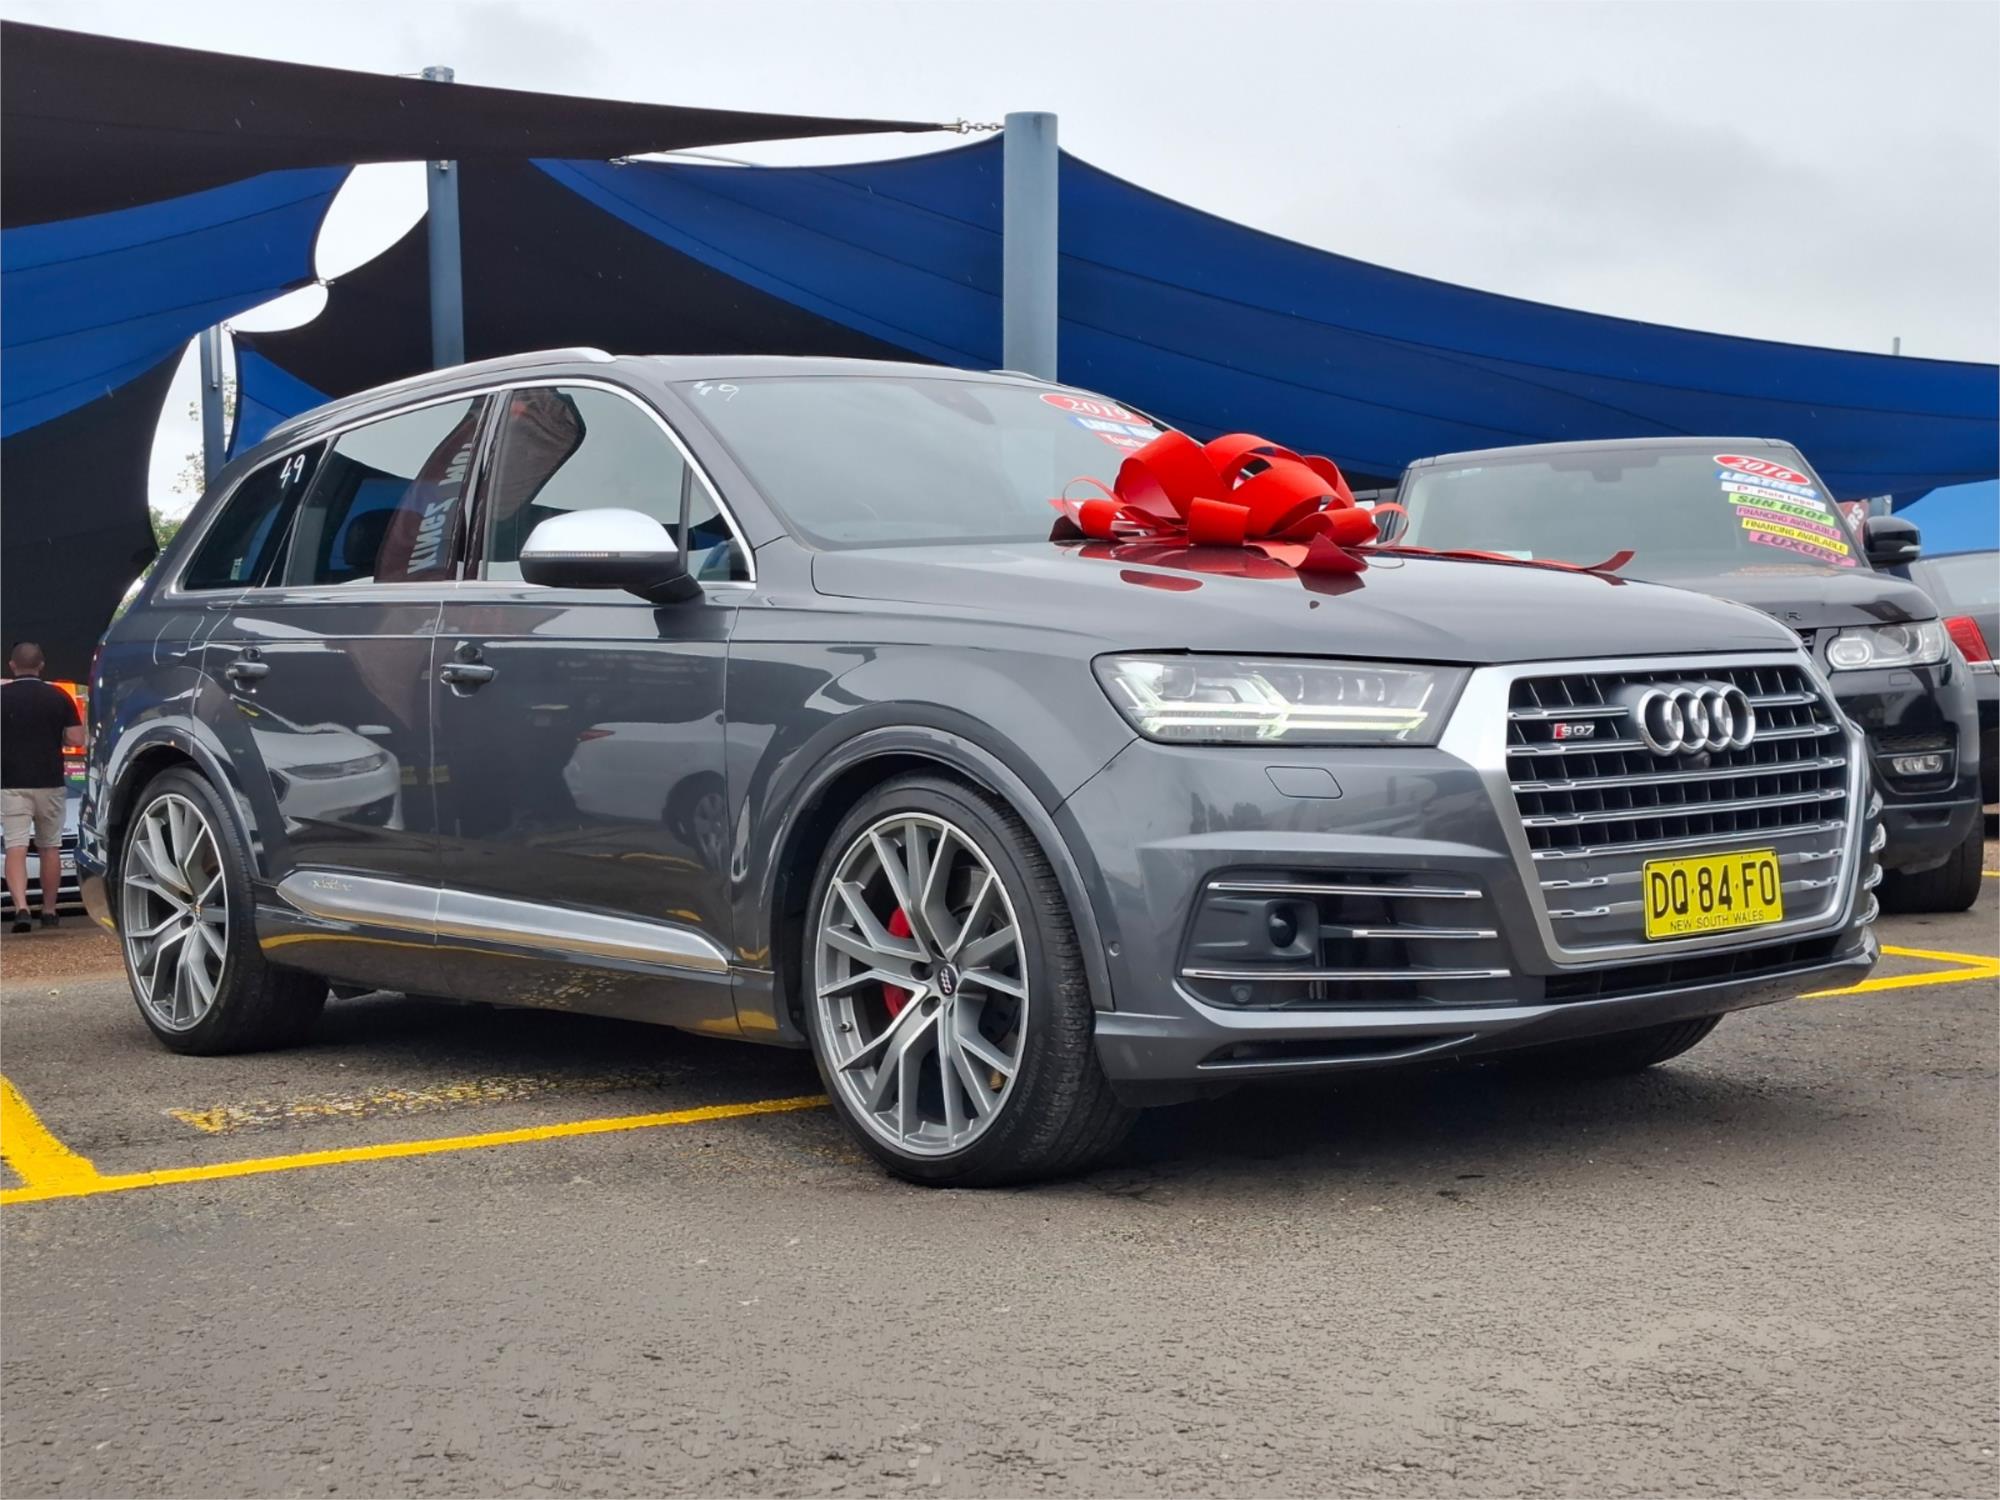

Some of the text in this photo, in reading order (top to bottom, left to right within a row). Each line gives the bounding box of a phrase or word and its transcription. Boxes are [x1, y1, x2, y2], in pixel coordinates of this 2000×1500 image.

[279, 453, 306, 489] 49
[1729, 458, 1793, 480] 2016
[1719, 471, 1817, 498] LEATHER
[1736, 495, 1832, 522] SUN ROOF
[1738, 507, 1838, 537] FINANCING AVAILABLE
[1847, 503, 1864, 531] RS
[1744, 519, 1847, 553] FINANCING AVAILABLE
[1756, 532, 1844, 563] LUXURY
[1560, 725, 1596, 737] SQ7
[1670, 909, 1765, 932] NEW SOUTH WALES
